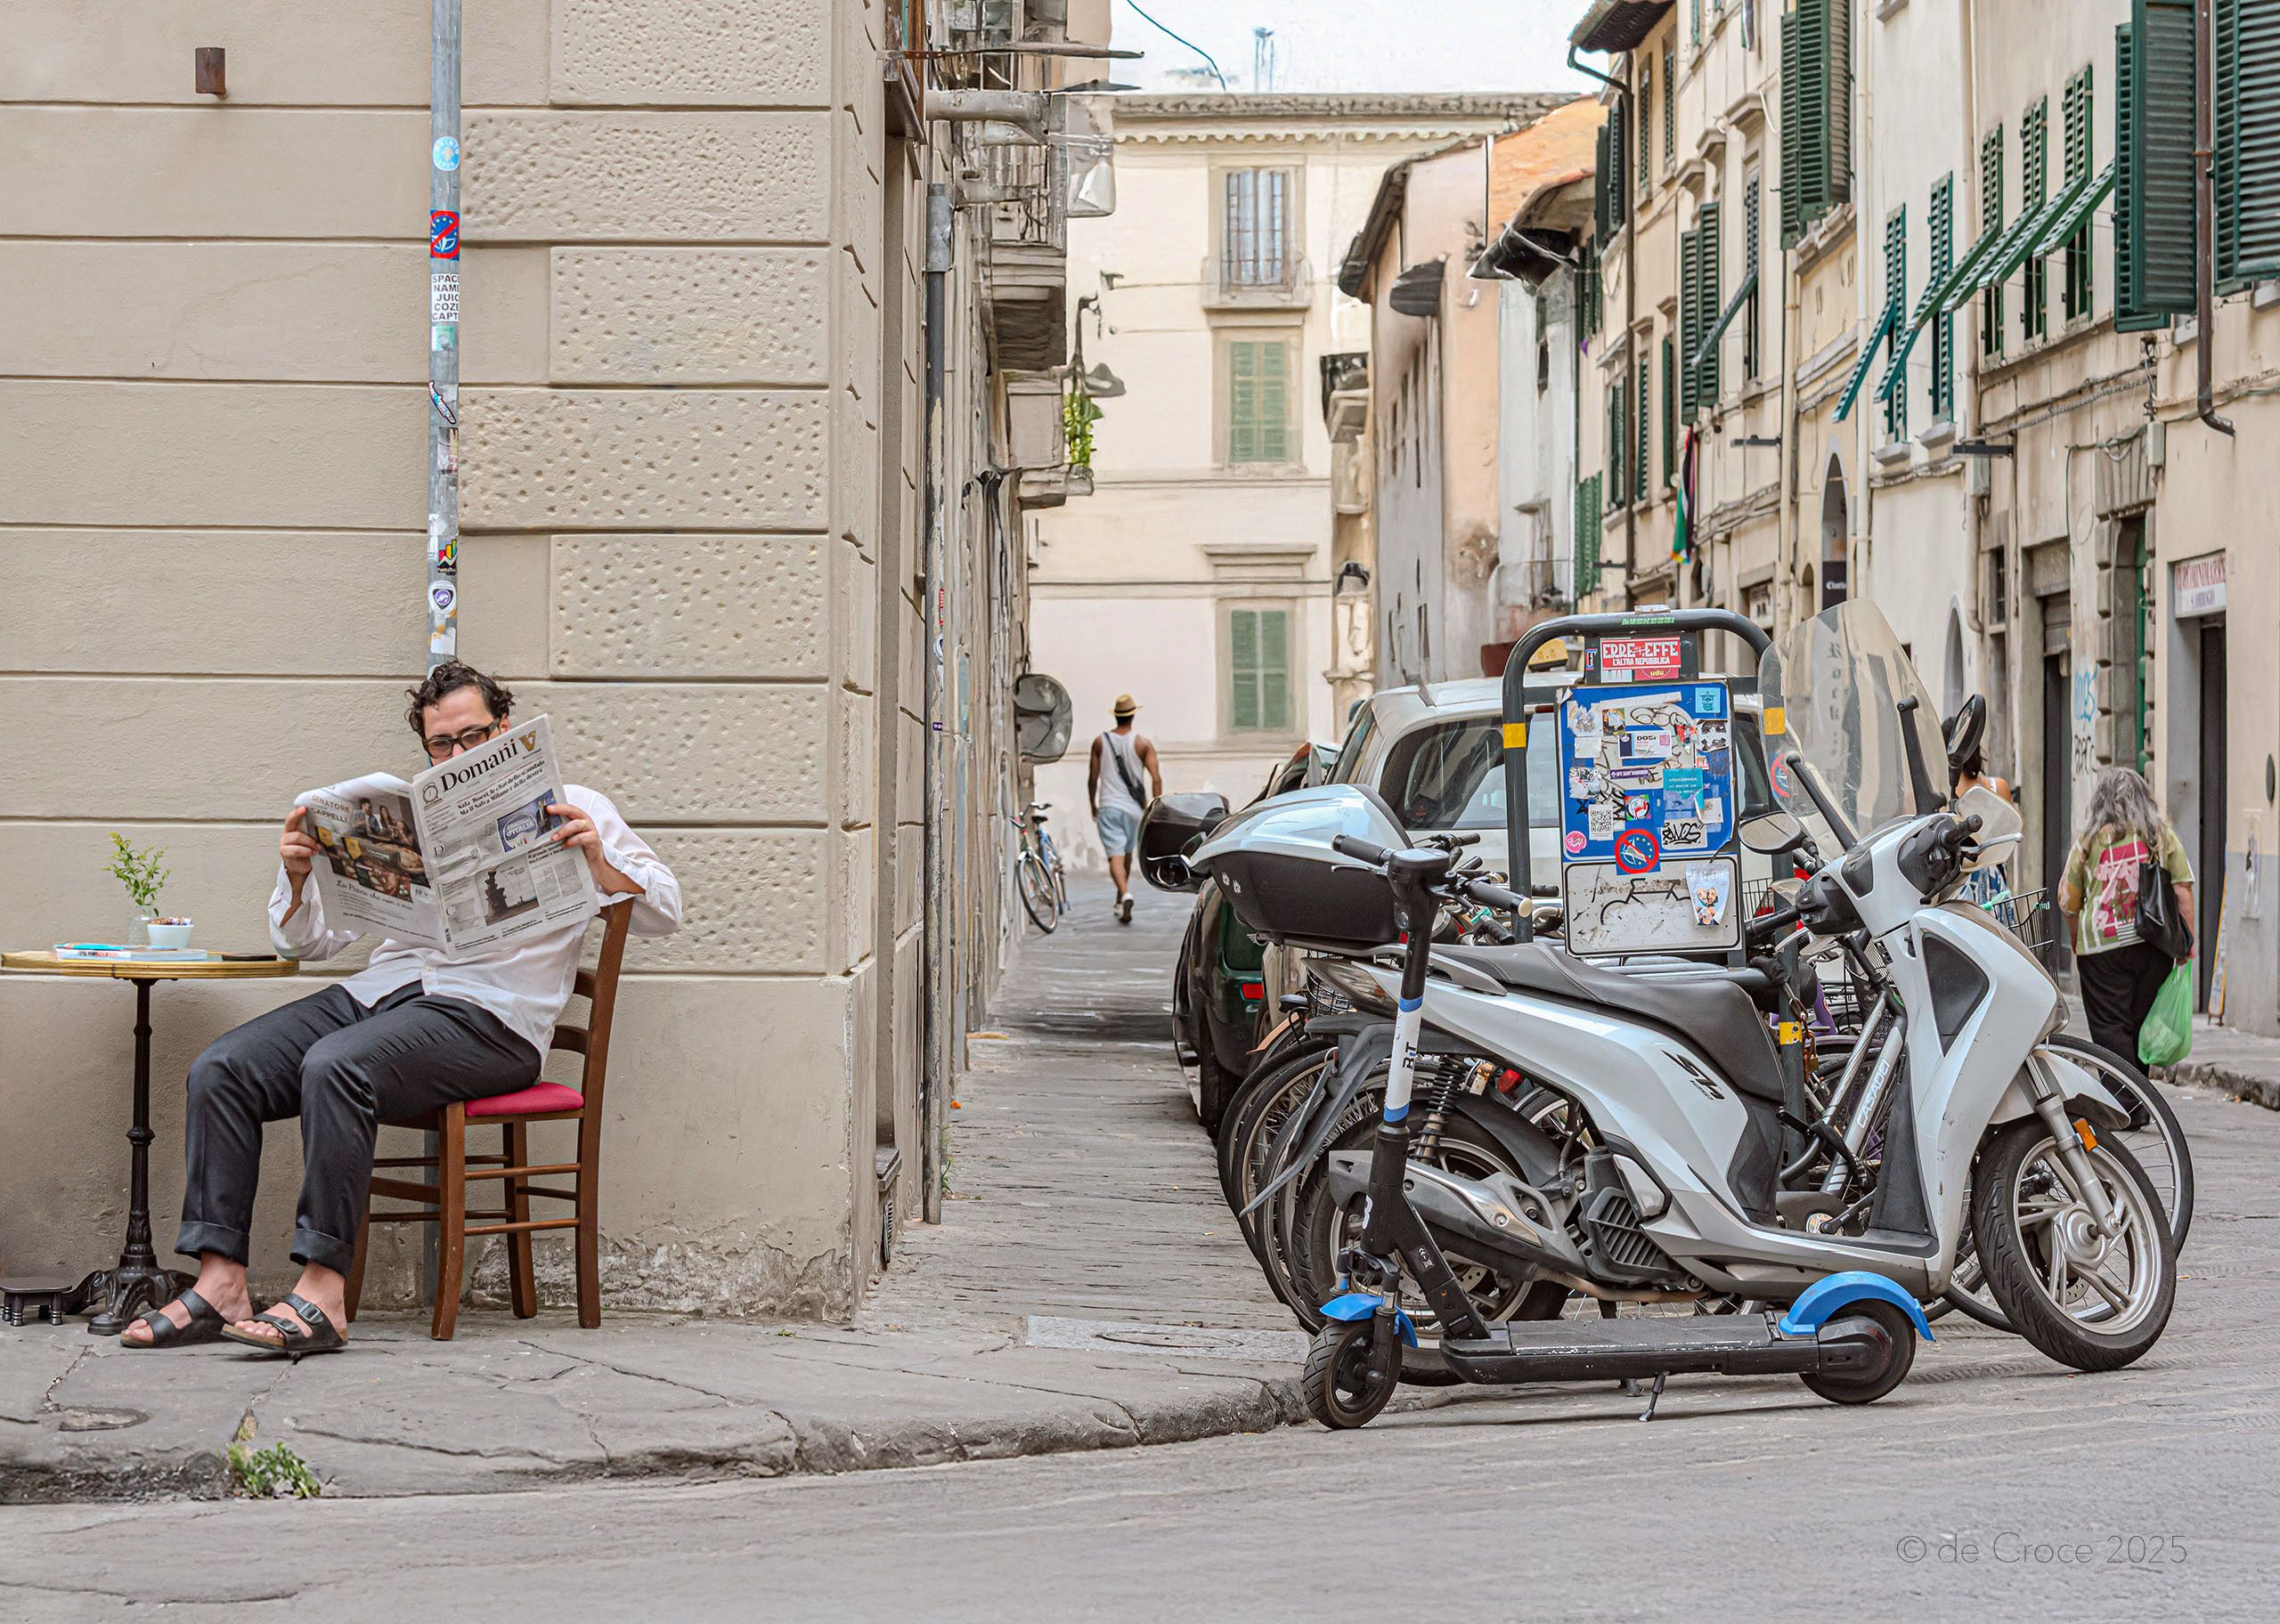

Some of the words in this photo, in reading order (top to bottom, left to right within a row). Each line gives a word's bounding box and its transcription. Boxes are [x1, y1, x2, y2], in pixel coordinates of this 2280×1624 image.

[1602, 642, 1635, 659] ERRE
[1644, 641, 1679, 657] EFFE
[1612, 658, 1634, 666] L'ALTRA
[1635, 656, 1671, 666] REPUBBLICA
[1649, 669, 1665, 677] udu
[439, 738, 518, 792] Domani
[1857, 1058, 1890, 1129] CASADEI
